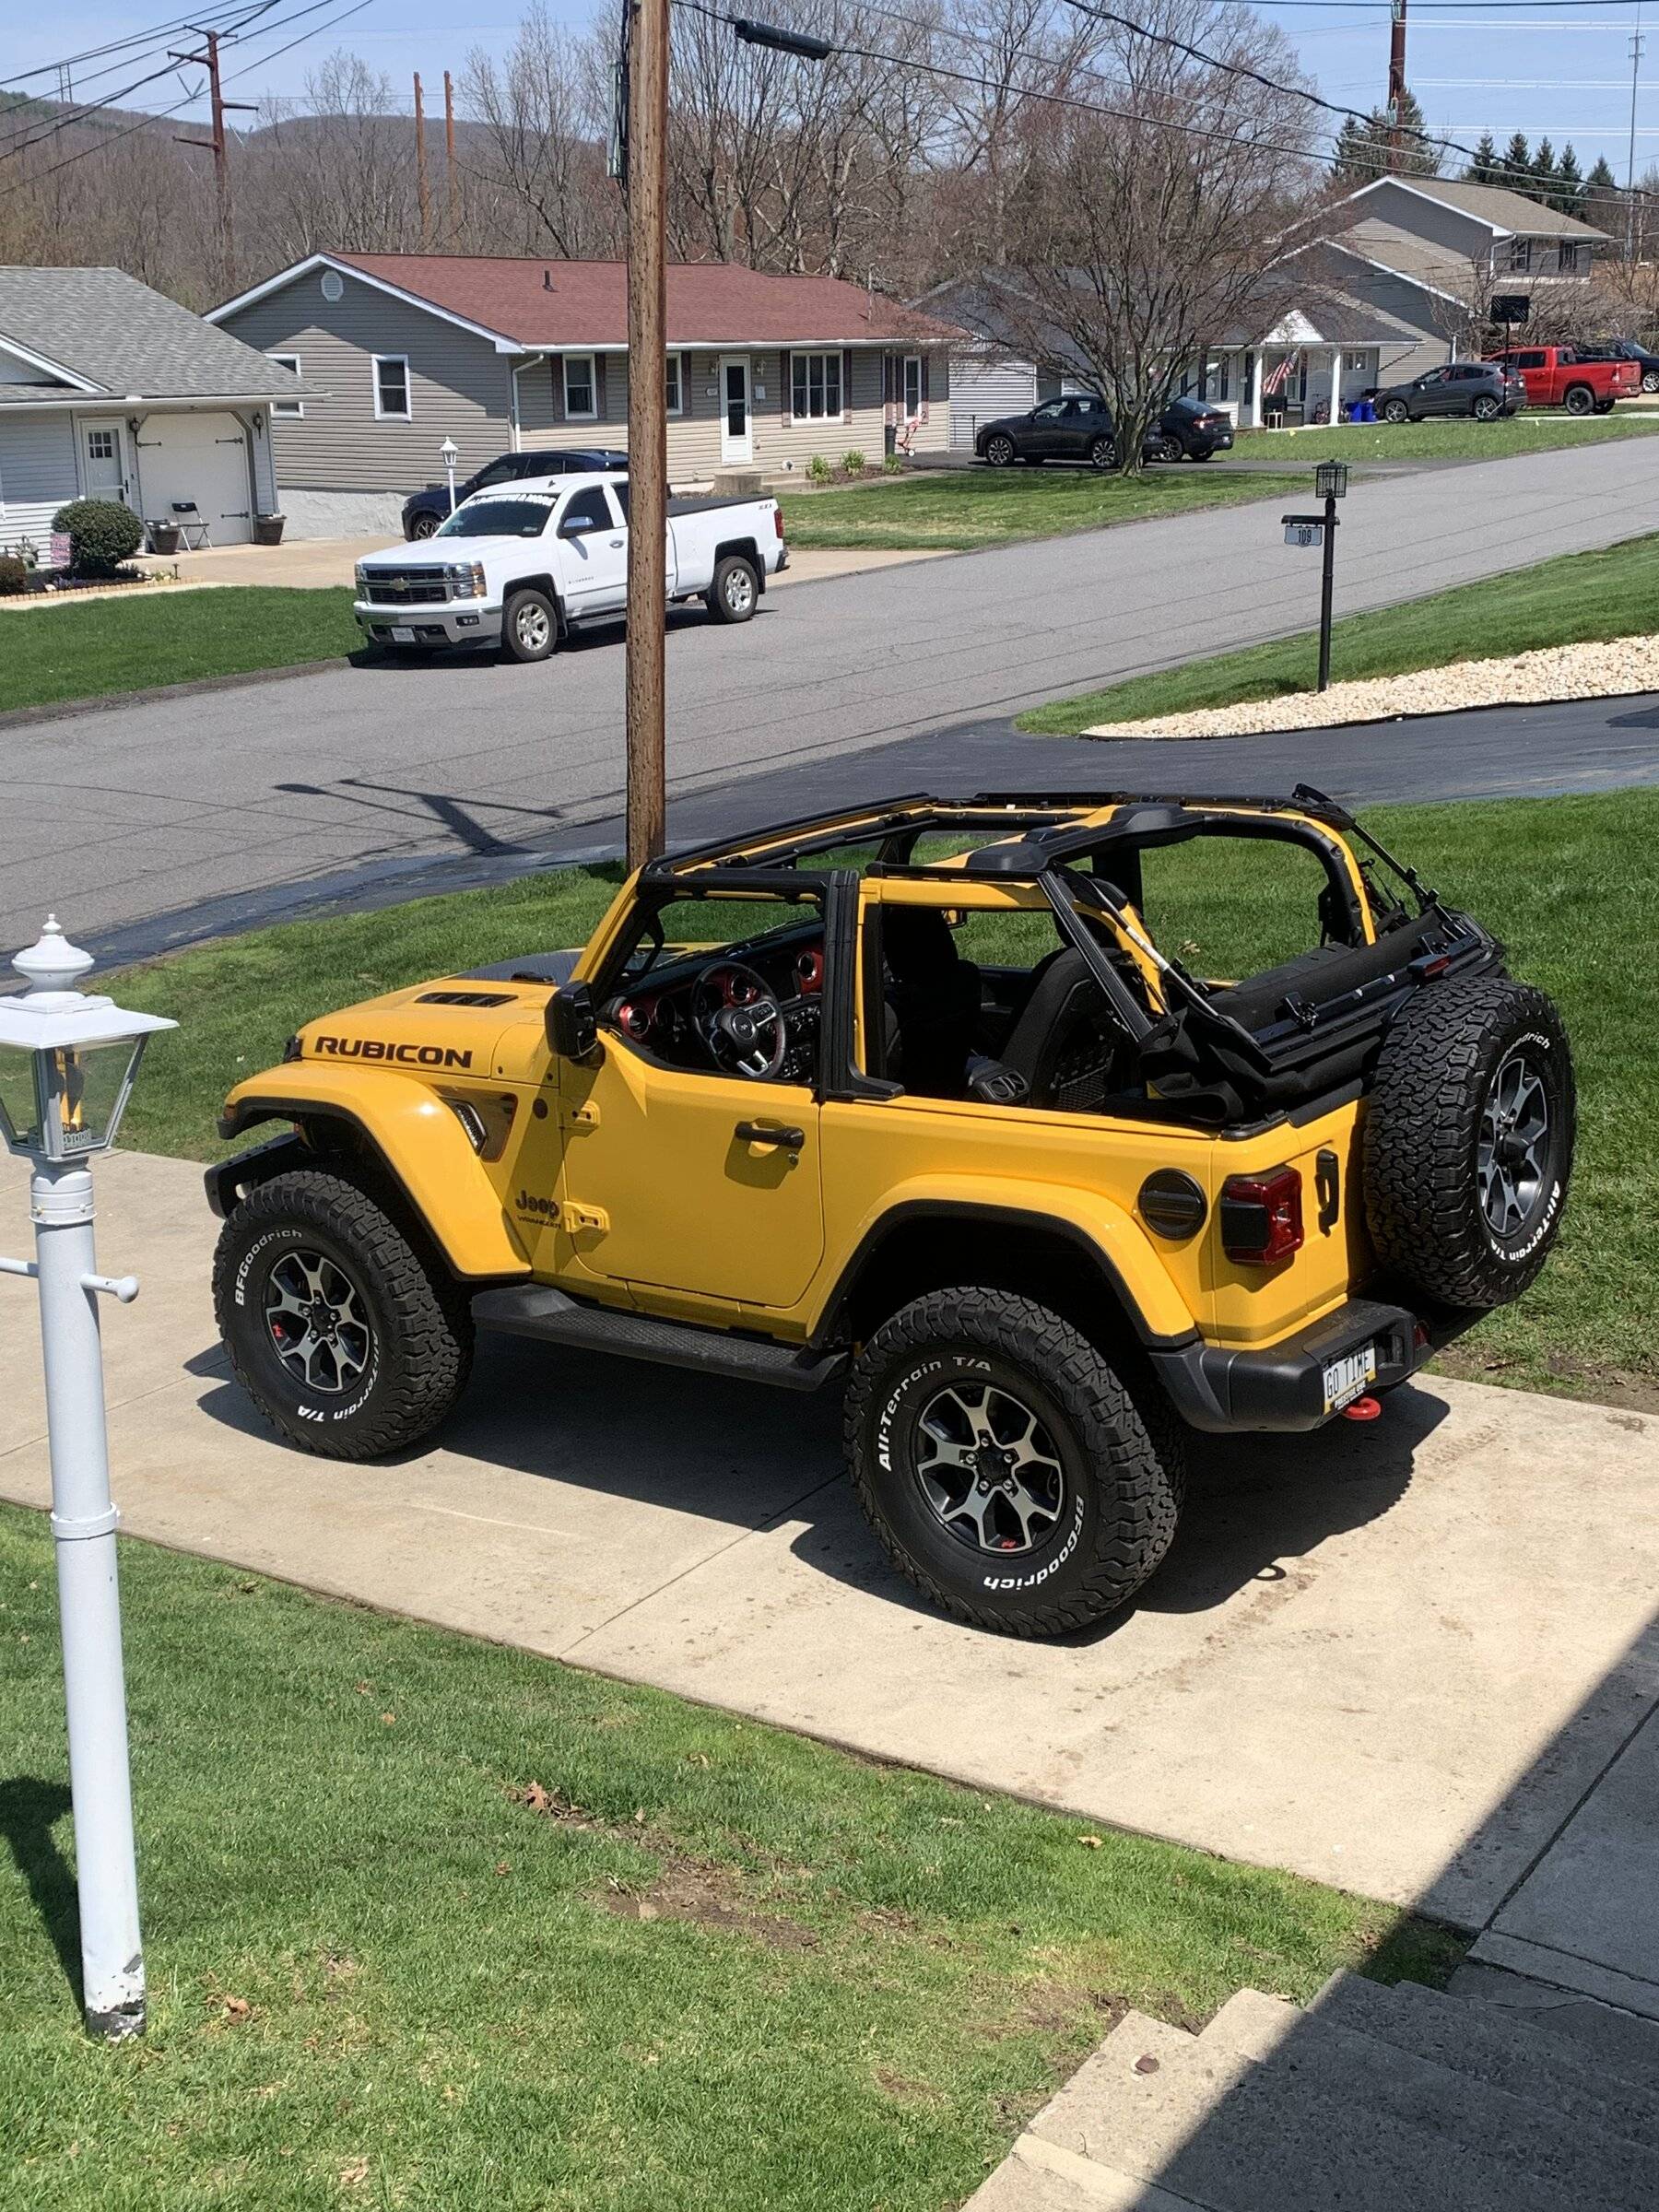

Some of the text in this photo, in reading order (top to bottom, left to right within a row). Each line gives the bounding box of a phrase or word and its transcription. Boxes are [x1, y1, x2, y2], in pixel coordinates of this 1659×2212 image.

[1298, 529, 1312, 543] 109
[314, 1036, 472, 1068] RUBICON
[516, 1190, 559, 1218] Jeep
[1509, 1181, 1560, 1262] All-Terrain
[235, 1229, 302, 1305] BFGoodrich
[298, 1329, 379, 1422] All-Terrain T/A
[1327, 1368, 1339, 1398] GO
[1344, 1345, 1370, 1385] TIME
[878, 1356, 992, 1472] All-Terrain T/A
[983, 1494, 1085, 1590] BFGoodrich
